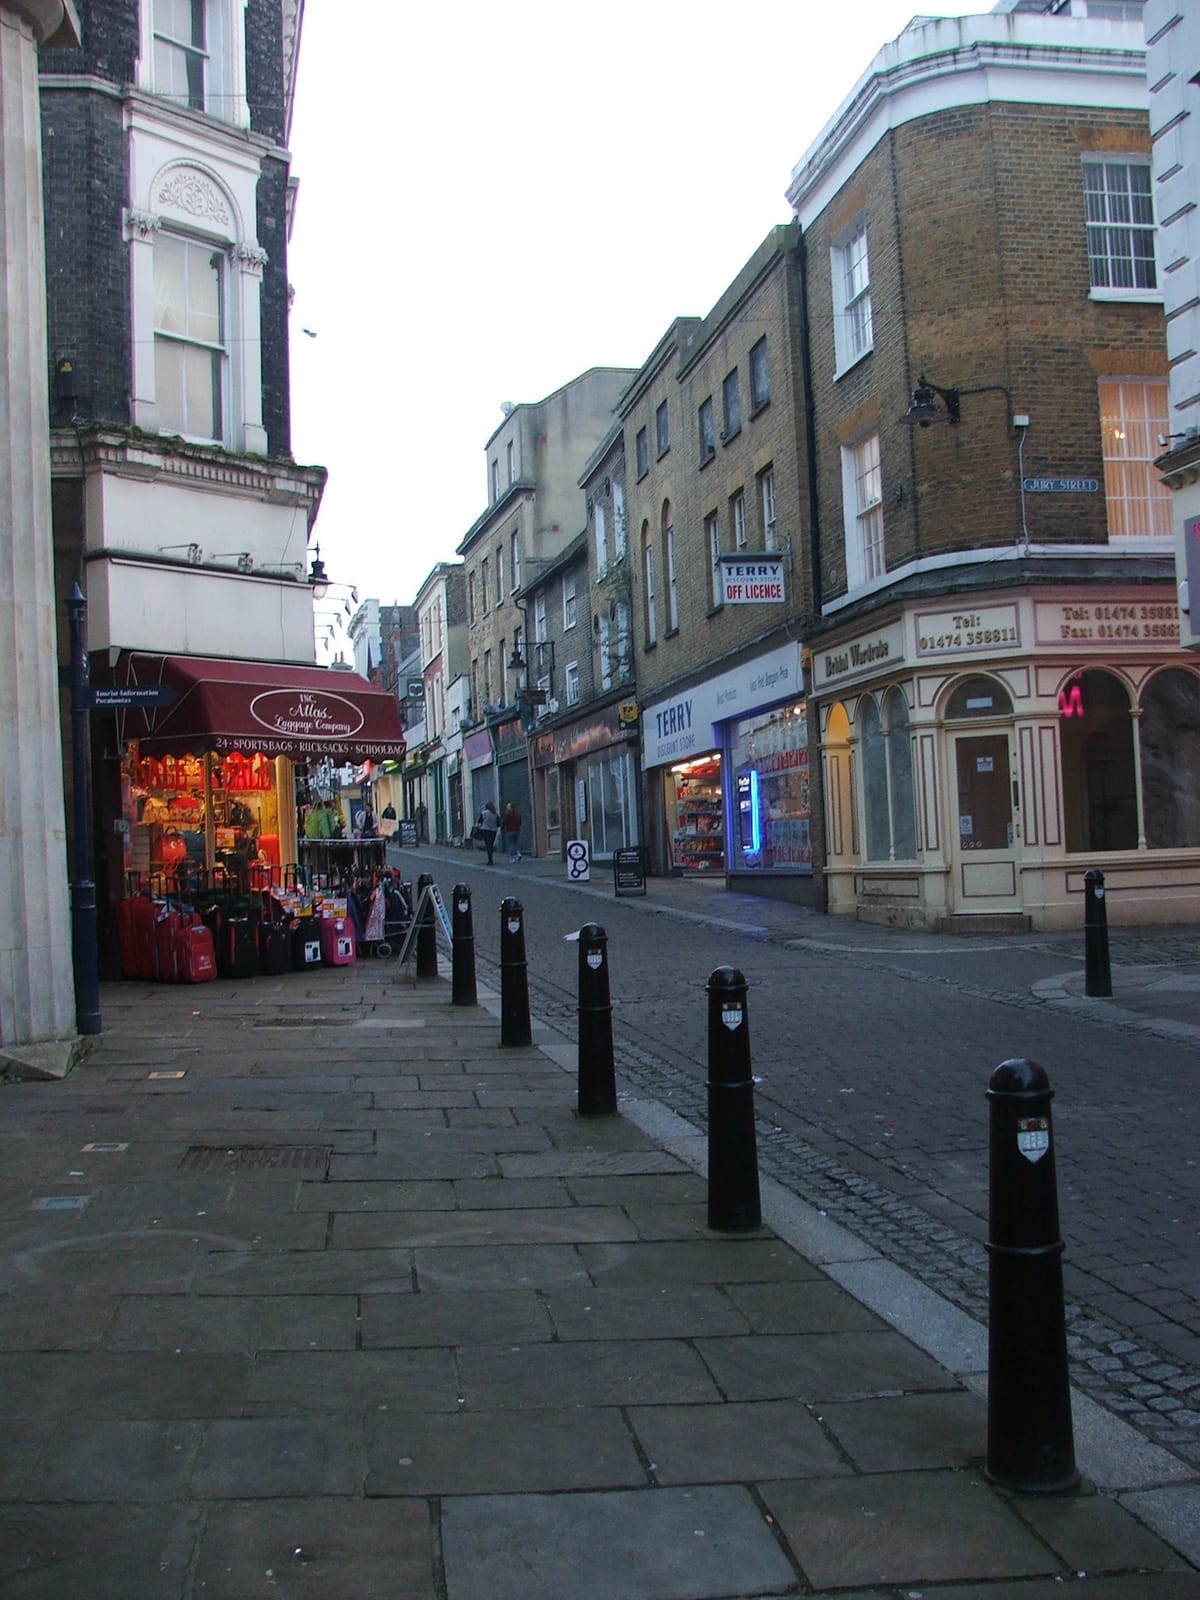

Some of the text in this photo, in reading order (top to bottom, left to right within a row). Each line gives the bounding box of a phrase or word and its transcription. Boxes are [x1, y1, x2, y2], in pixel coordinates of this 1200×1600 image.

[1030, 479, 1093, 490] JURY STREET
[725, 565, 779, 577] TERRY
[726, 583, 782, 600] OFF LICENCE
[1061, 606, 1089, 620] Tel:
[1094, 606, 1137, 620] 01474
[952, 615, 981, 630] Tel:
[919, 626, 1017, 650] 01474 358811
[1060, 624, 1093, 638] Fax:
[1098, 624, 1140, 638] 01474
[824, 639, 889, 678] Bridal Wardrobe
[119, 689, 159, 697] Information
[274, 713, 351, 734] Luggage Company
[655, 699, 693, 739] TERRY
[299, 741, 349, 753] RUCKSACKS
[657, 733, 696, 759] DISCOUNT STORE
